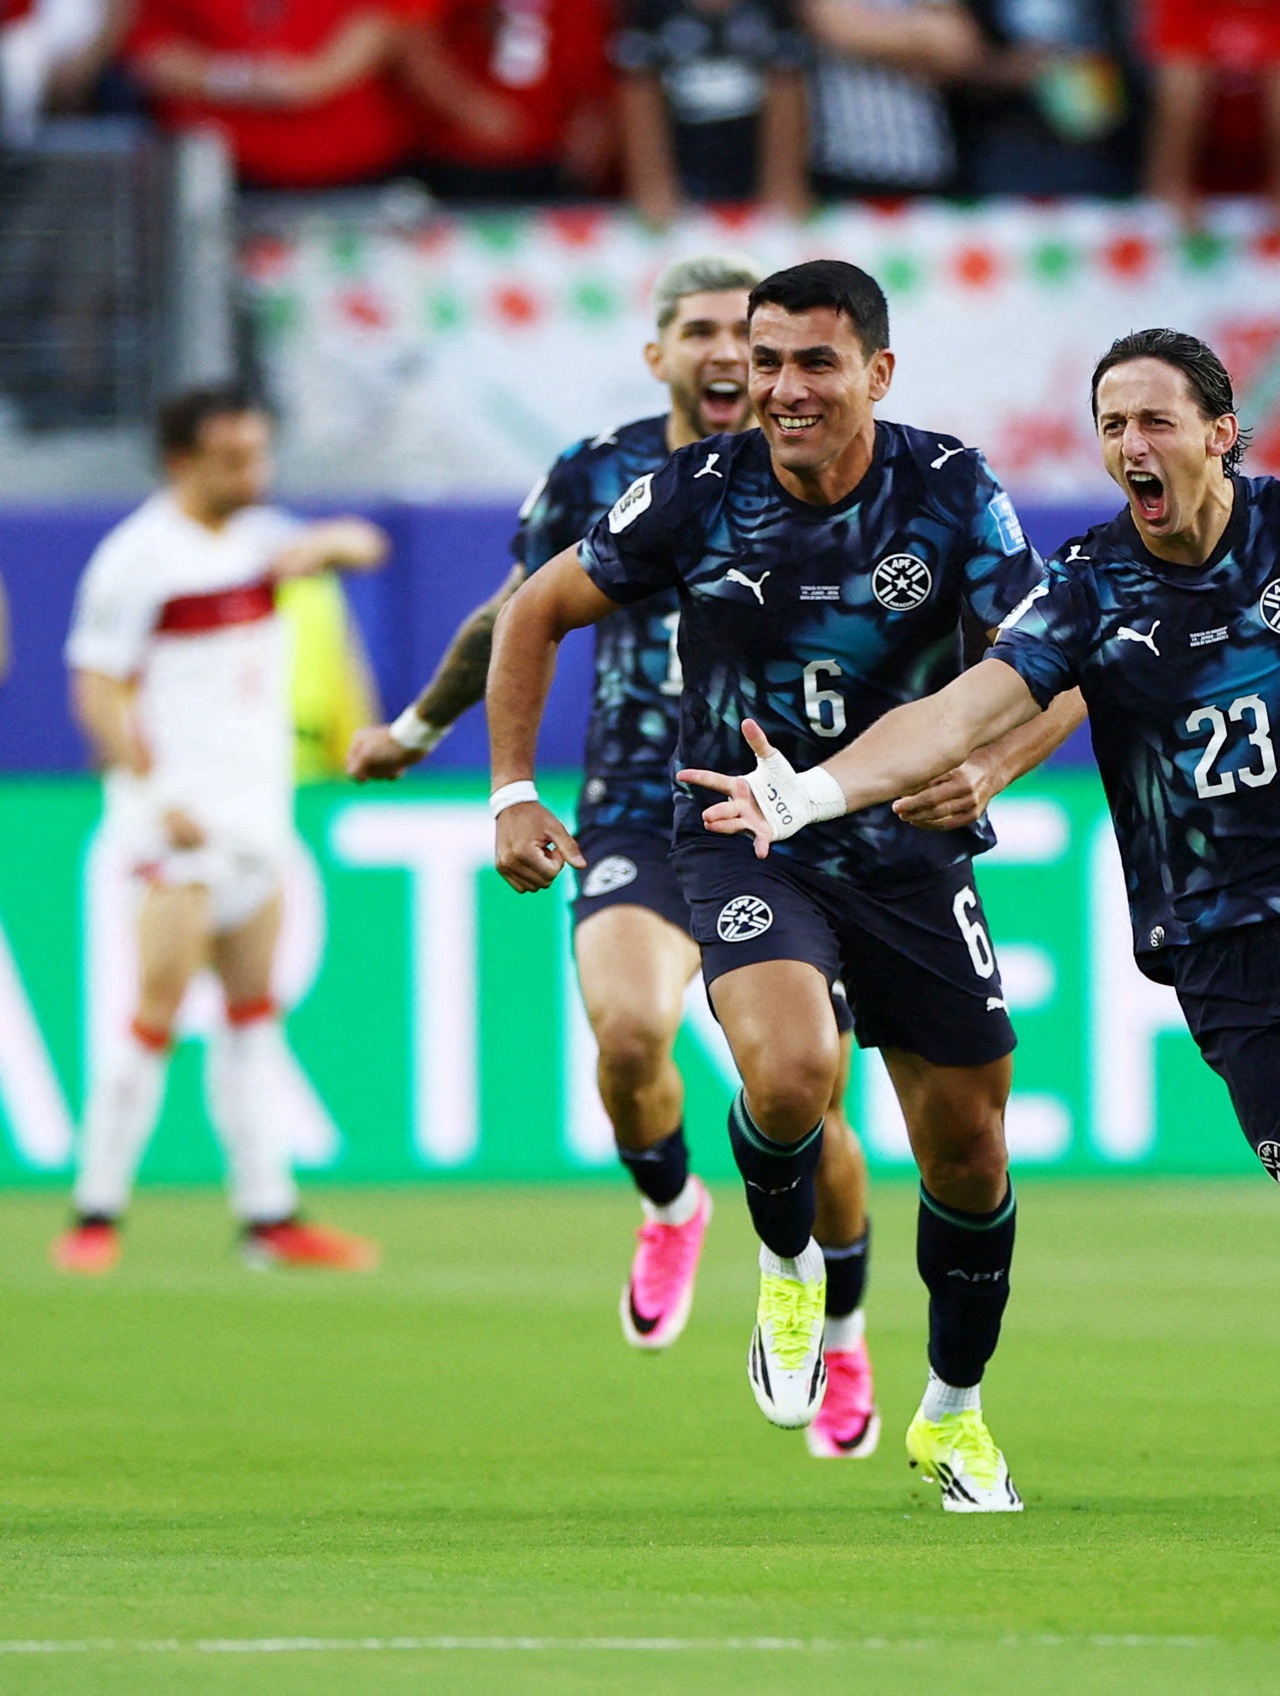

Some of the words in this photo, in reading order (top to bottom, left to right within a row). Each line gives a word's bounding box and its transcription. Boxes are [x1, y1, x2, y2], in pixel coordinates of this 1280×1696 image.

[891, 559, 911, 569] APF
[803, 658, 847, 738] 6
[1185, 694, 1278, 799] 23
[953, 885, 995, 979] 6
